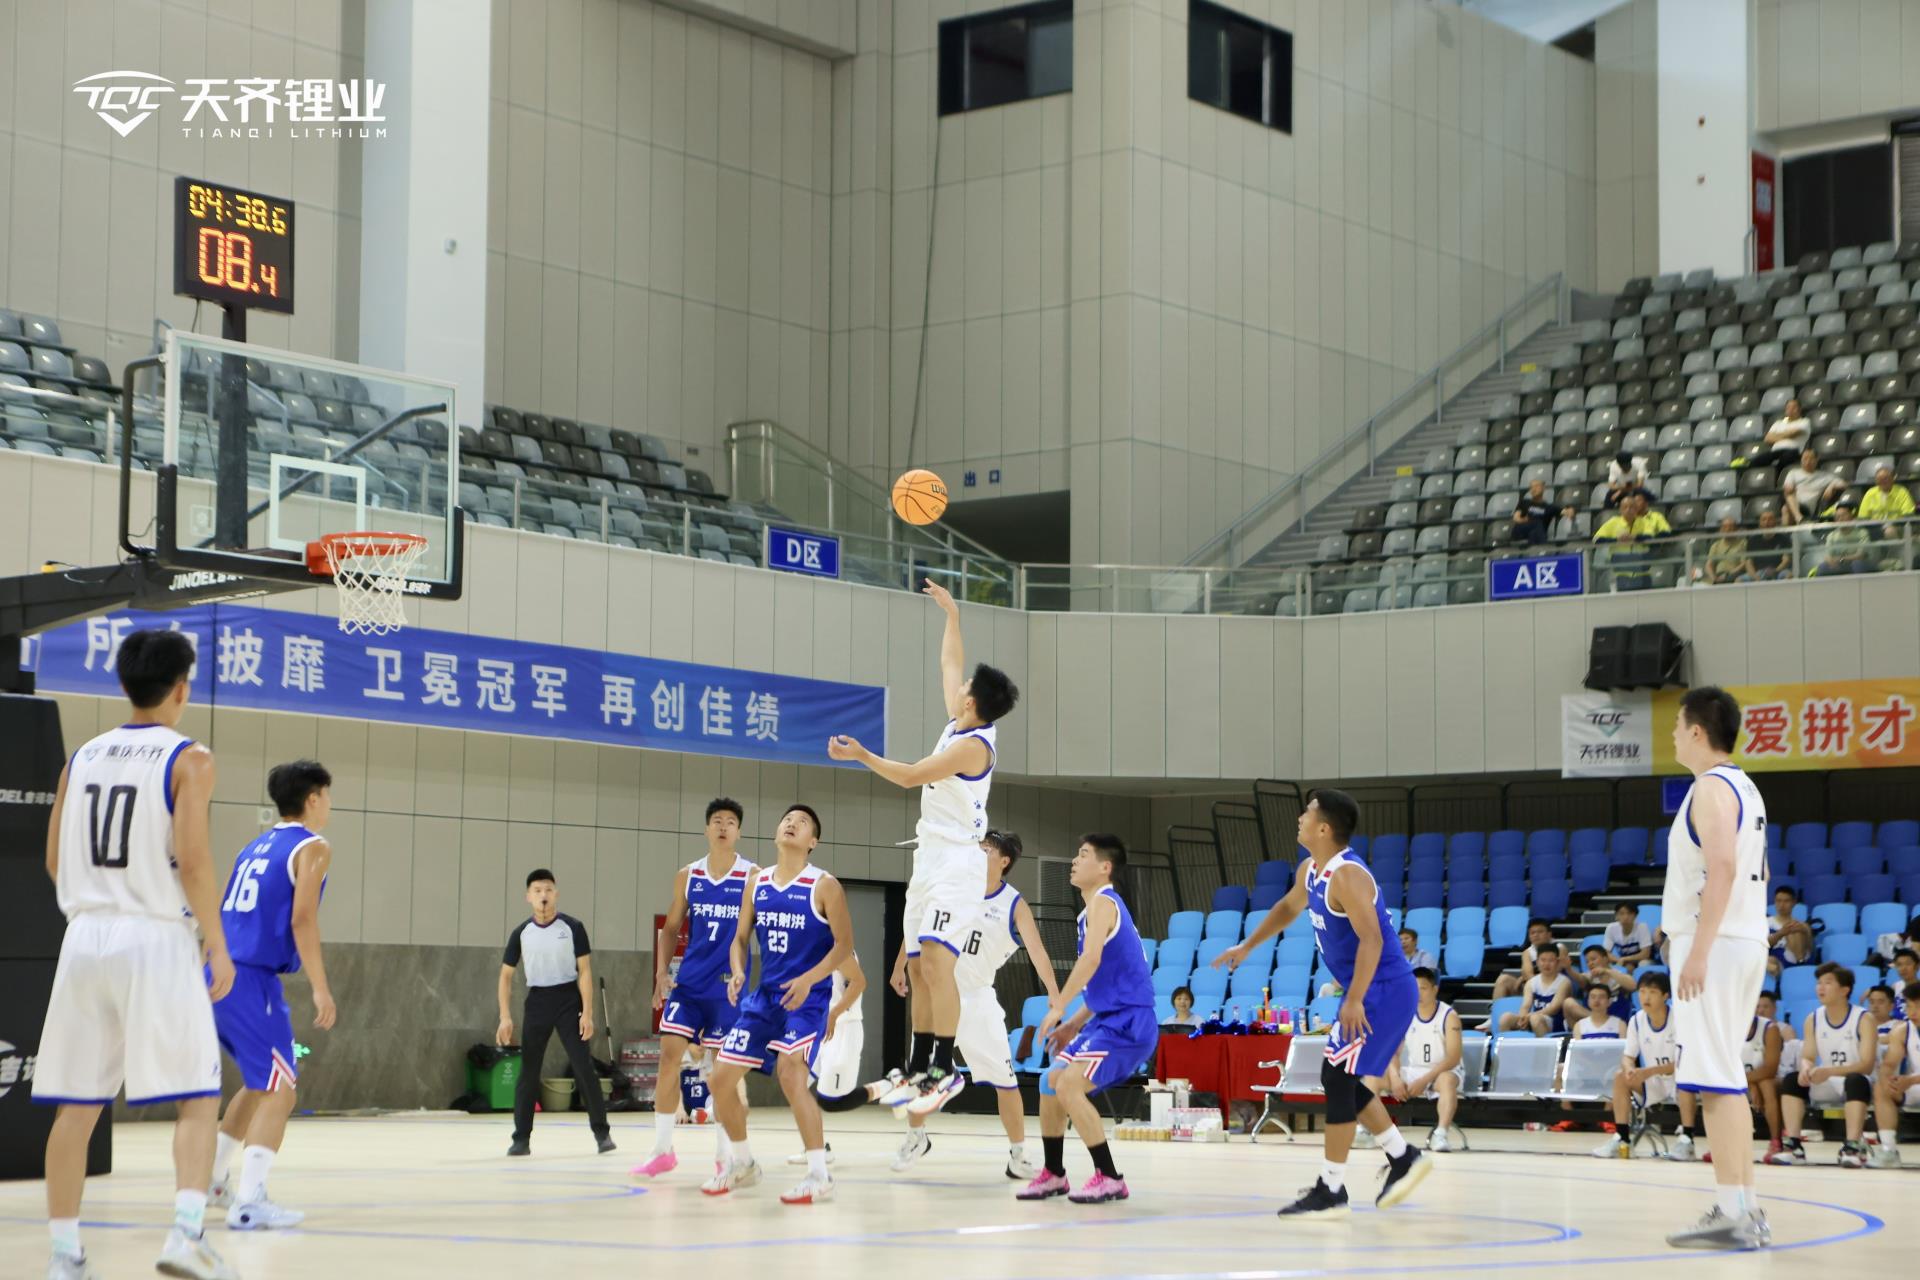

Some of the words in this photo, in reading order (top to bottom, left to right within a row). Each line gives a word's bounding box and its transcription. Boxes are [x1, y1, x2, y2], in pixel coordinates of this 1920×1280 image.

[189, 184, 288, 236] 04:38.6
[199, 227, 279, 298] 08.4
[963, 469, 1001, 487] 出口
[786, 538, 822, 569] D区
[1512, 561, 1560, 590] A区
[363, 646, 568, 718] 卫冕冠军
[600, 673, 780, 743] 再创佳绩
[1744, 695, 1914, 755] 爱拼才
[85, 783, 137, 868] 10
[222, 858, 270, 913] 16
[707, 921, 720, 942] 7
[932, 909, 951, 931] 12
[768, 930, 789, 954] 23
[667, 1002, 680, 1021] 7
[724, 1028, 751, 1052] 23
[1423, 1043, 1431, 1063] 8
